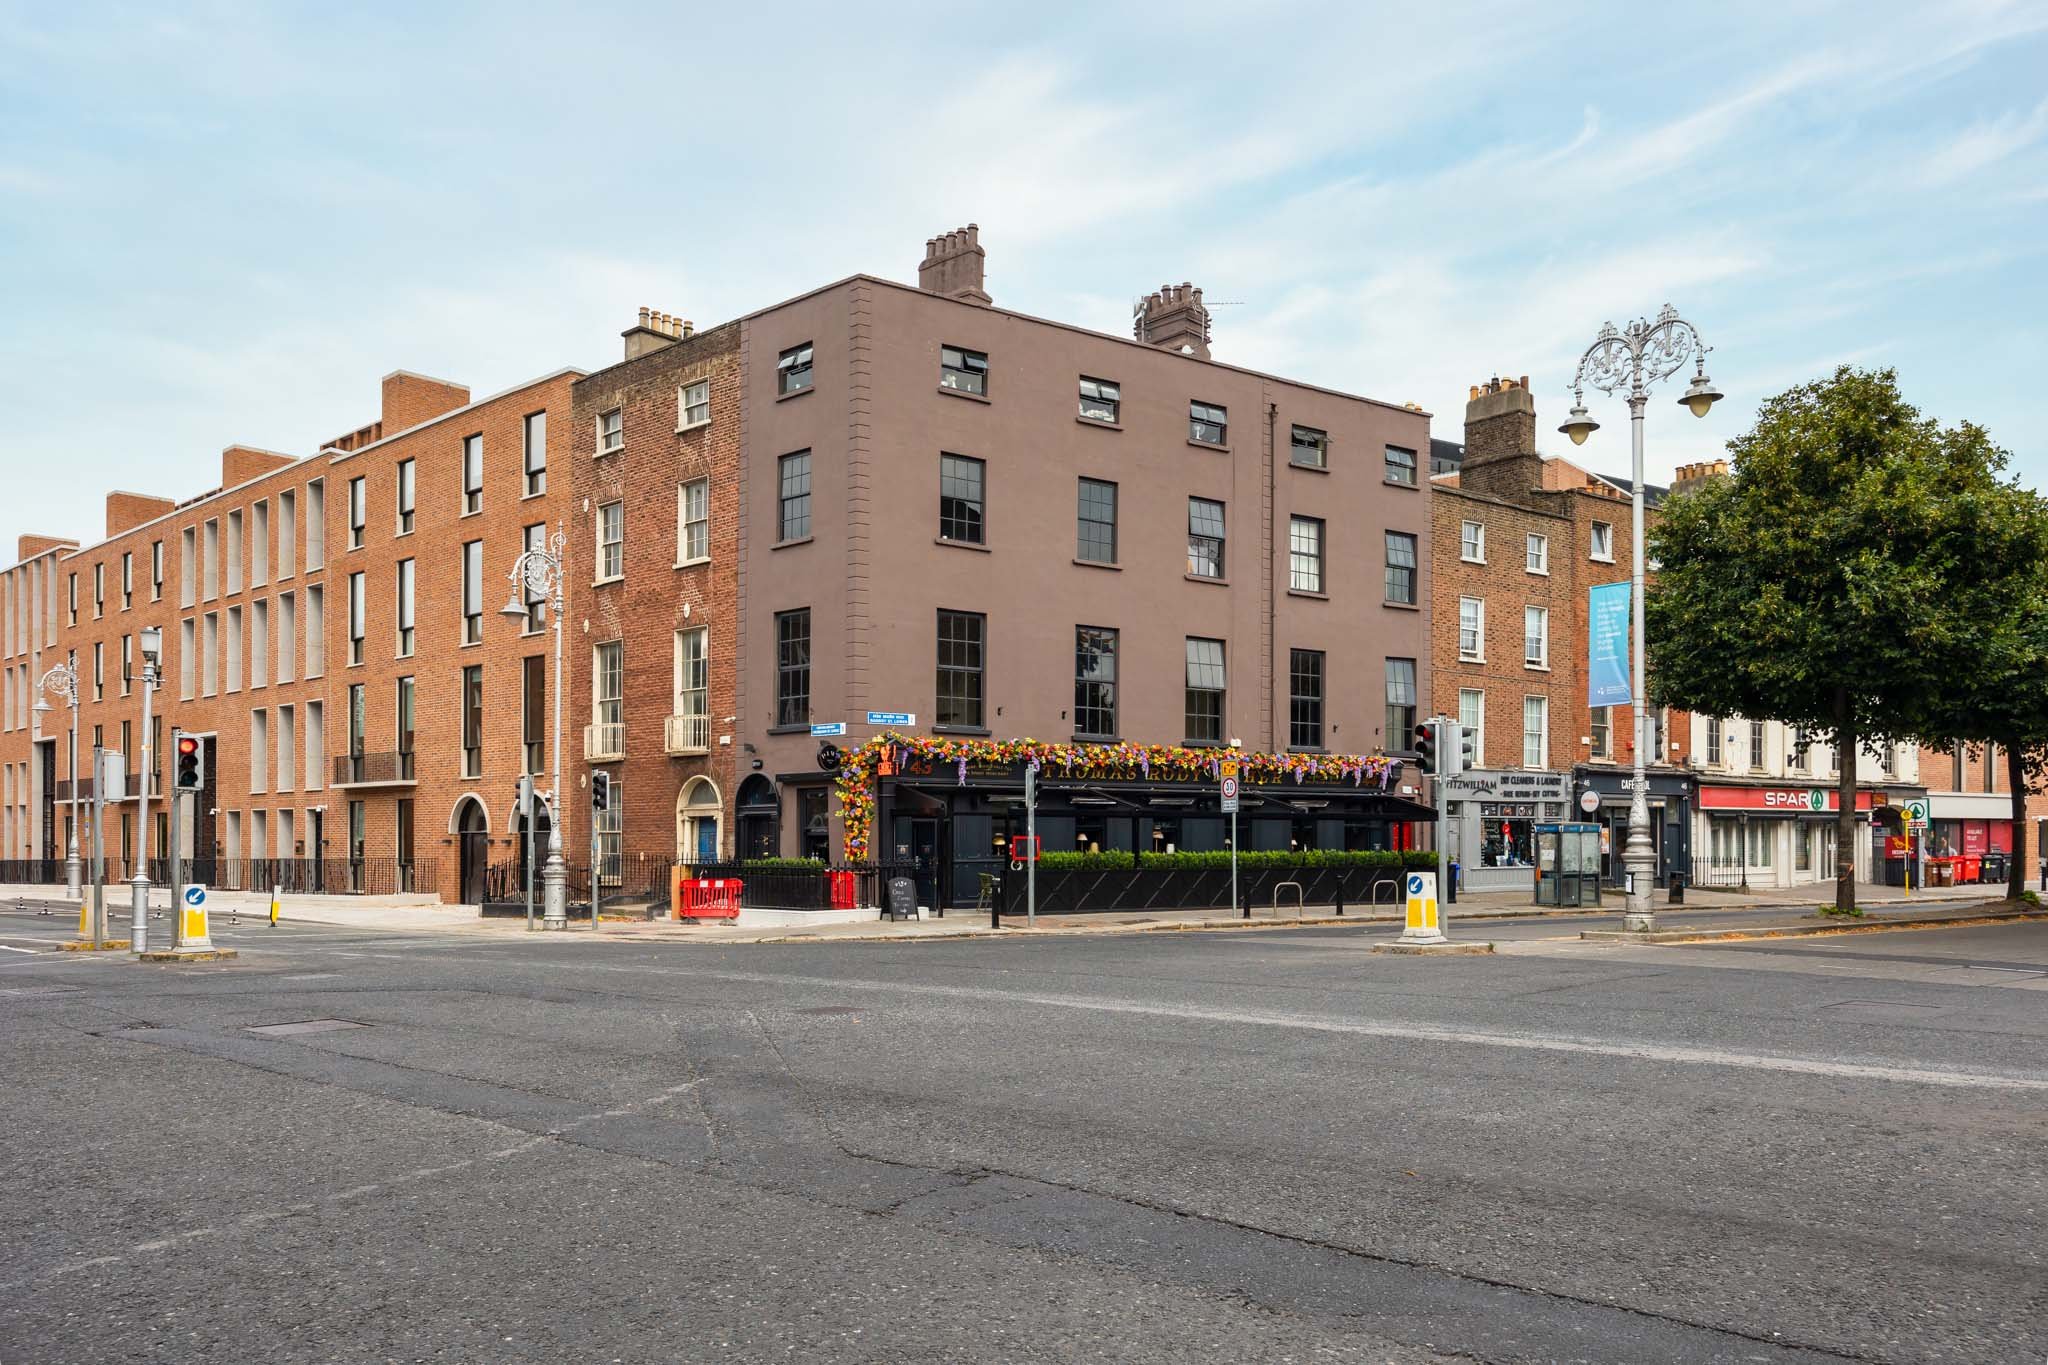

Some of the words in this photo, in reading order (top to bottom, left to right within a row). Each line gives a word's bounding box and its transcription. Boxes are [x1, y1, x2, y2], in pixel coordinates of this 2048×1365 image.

[1043, 765, 1137, 780] THOMAS
[1150, 766, 1200, 782] RODY
[1226, 782, 1233, 791] 30
[1765, 792, 1809, 806] SPAR
